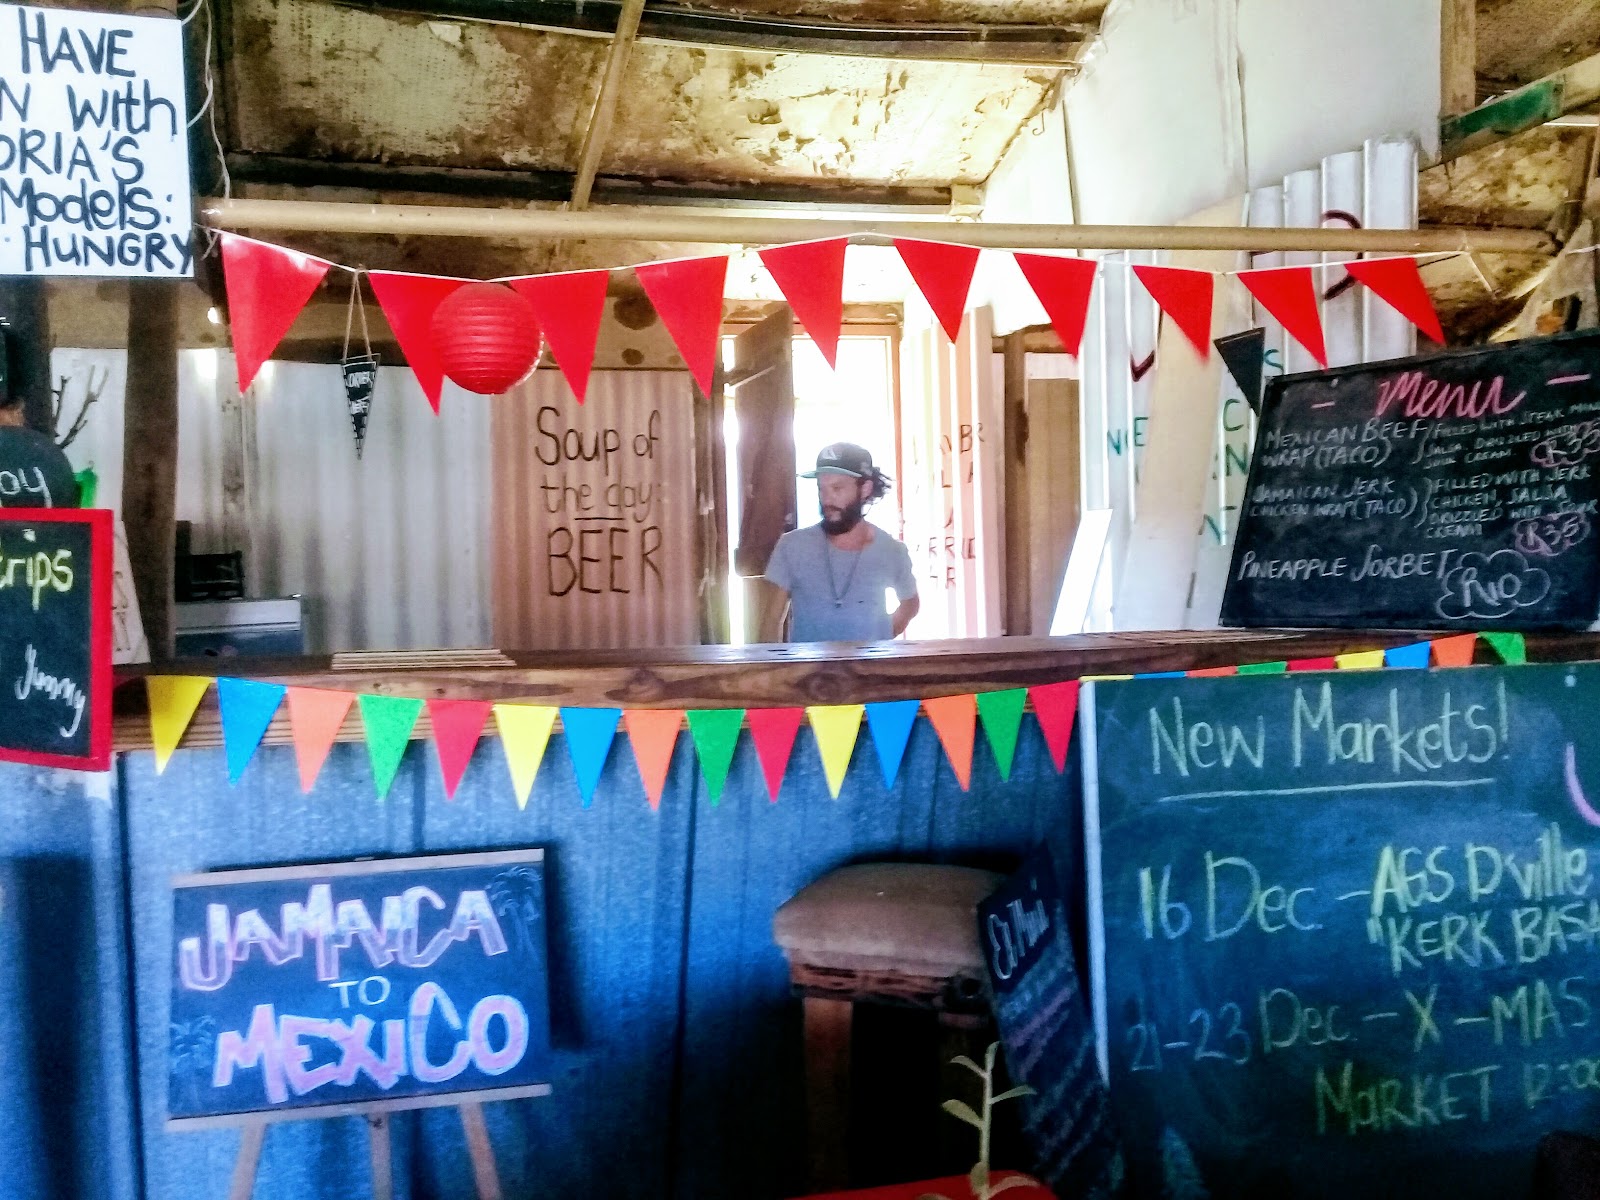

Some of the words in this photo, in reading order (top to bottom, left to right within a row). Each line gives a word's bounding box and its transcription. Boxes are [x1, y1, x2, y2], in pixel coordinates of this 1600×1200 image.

[18, 7, 137, 78] HAVE
[23, 224, 193, 275] HUNGRY
[1374, 371, 1528, 418] Menu
[534, 406, 621, 477] Soup
[633, 410, 662, 460] of
[1263, 424, 1358, 450] MEXICAN
[1360, 415, 1429, 442] BEEF
[540, 474, 595, 514] the
[1343, 476, 1396, 499] JERK
[546, 525, 664, 597] BEER
[1237, 551, 1348, 581] PINEAPPLE
[1149, 697, 1266, 777] New
[1292, 677, 1511, 774] Markets!
[1139, 864, 1193, 940] 16
[1203, 850, 1323, 942] Dec
[178, 883, 509, 992] JAMAICA
[1387, 909, 1506, 978] KERK
[329, 976, 391, 1010] TO
[212, 981, 530, 1105] MEXICO
